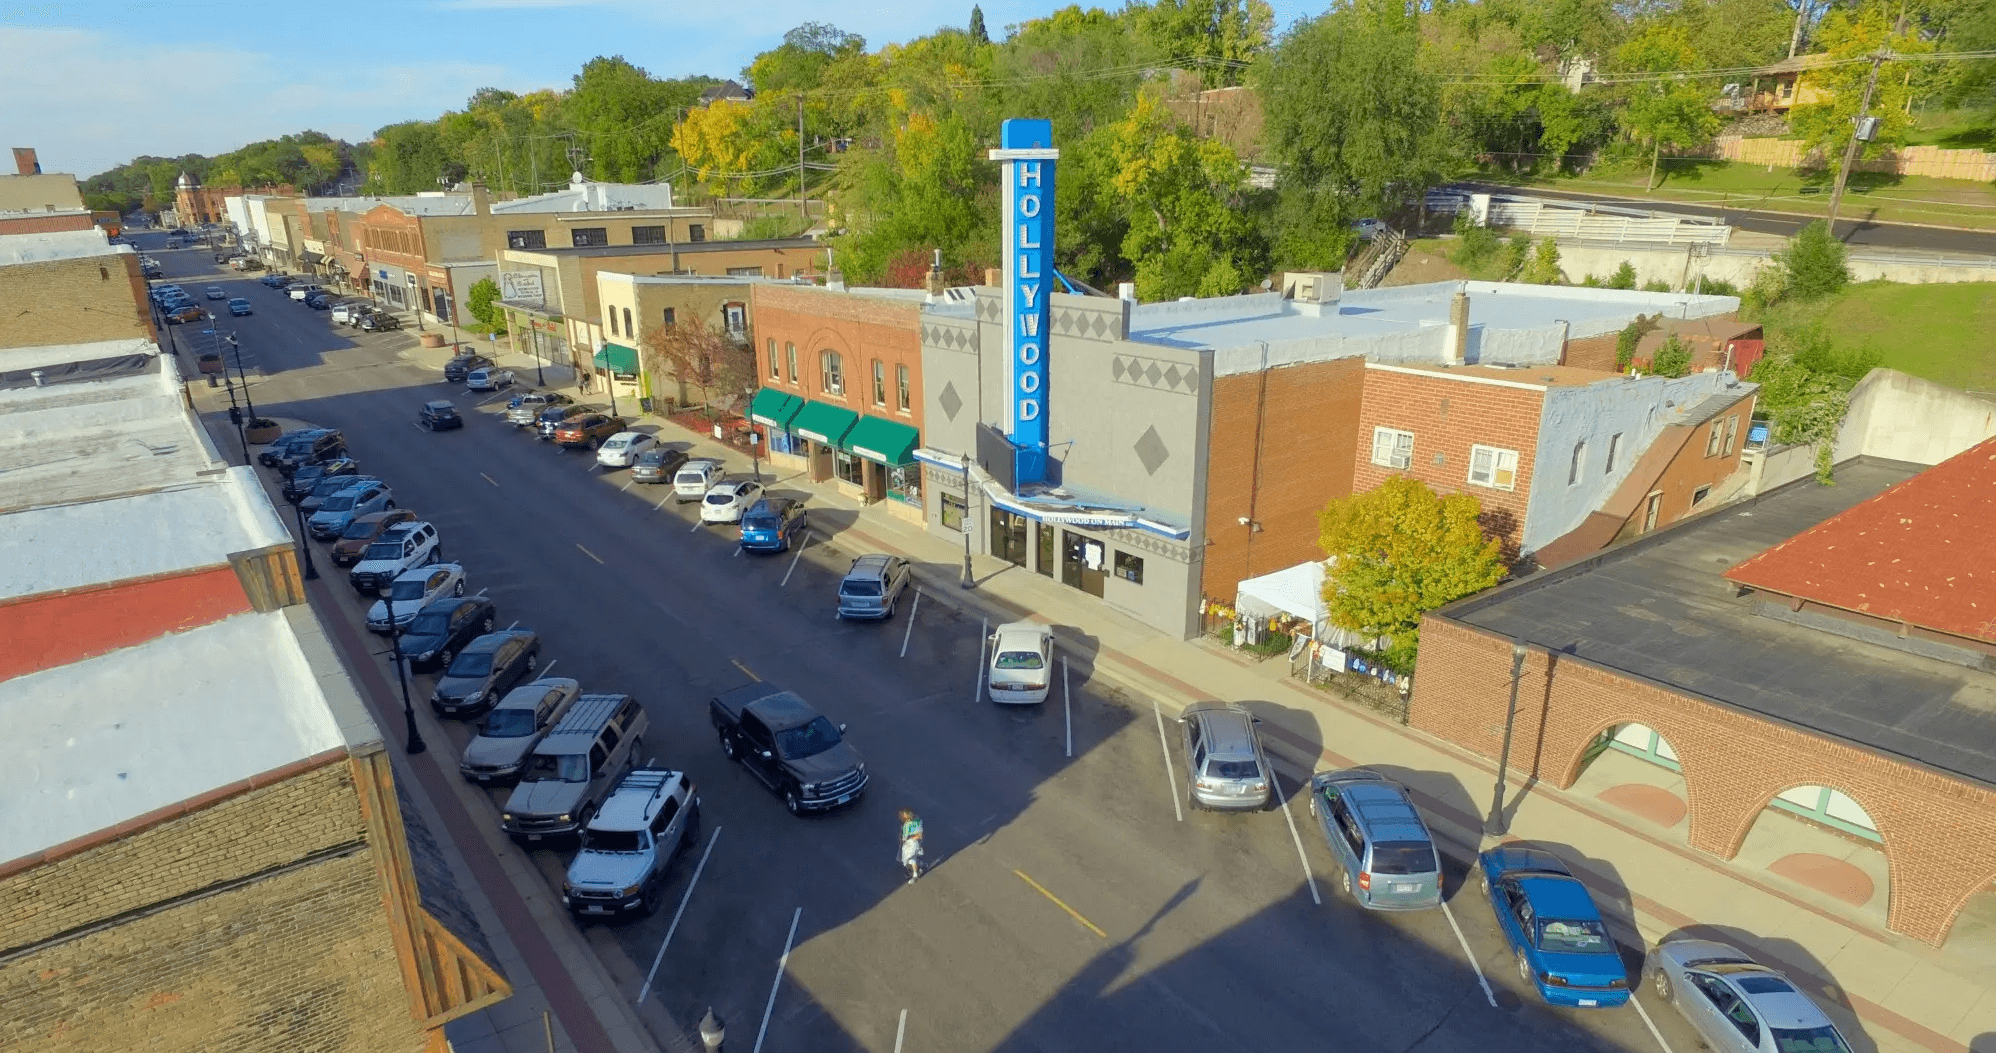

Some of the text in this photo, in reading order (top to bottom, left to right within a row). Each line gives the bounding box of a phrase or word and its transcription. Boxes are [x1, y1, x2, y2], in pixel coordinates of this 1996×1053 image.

[1019, 162, 1041, 421] HOLLYWOOD
[1042, 516, 1090, 525] HOLLYWOOD
[1091, 518, 1103, 526] ON
[1104, 519, 1125, 527] MAIN
[962, 525, 973, 533] 20
